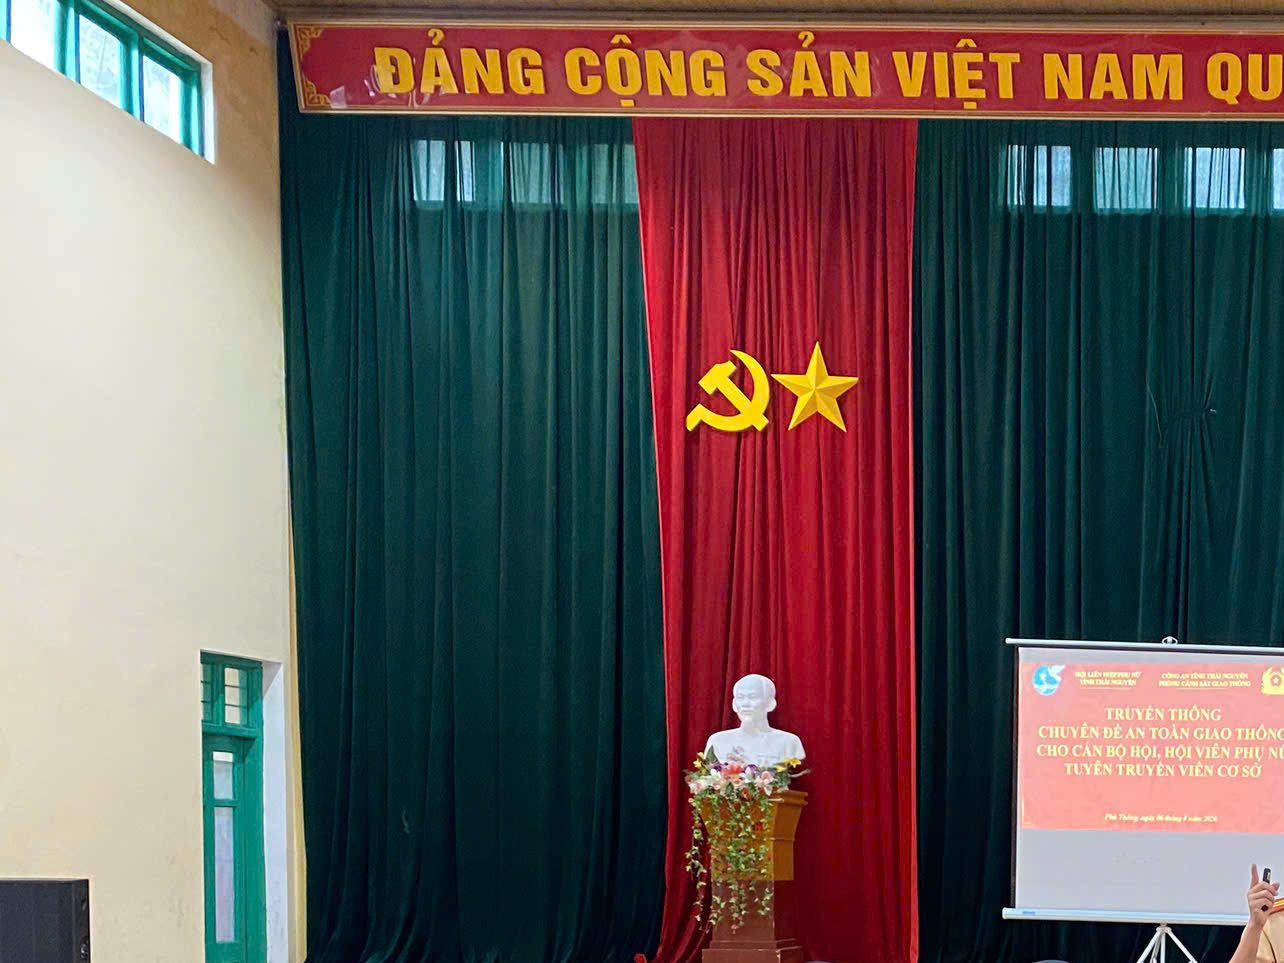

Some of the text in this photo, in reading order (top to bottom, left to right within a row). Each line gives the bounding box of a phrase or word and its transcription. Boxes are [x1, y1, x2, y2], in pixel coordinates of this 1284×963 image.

[374, 28, 546, 95] ĐẢNG
[564, 34, 727, 108] CỘNG
[745, 31, 871, 97] SẢN
[892, 39, 1021, 111] VIỆT
[1042, 52, 1184, 101] NAM
[1169, 704, 1222, 721] THÔNG
[1038, 721, 1100, 739] CHUYÊN
[1126, 727, 1146, 739] AN
[1149, 723, 1190, 740] TOÀN
[1193, 727, 1232, 740] GIAO
[1036, 744, 1069, 757] CHO
[1072, 741, 1103, 757] CÁN
[1105, 743, 1127, 761] BỘ
[1130, 744, 1161, 761] HỘI,
[1164, 744, 1193, 761] HỘI
[1195, 742, 1231, 759] VIÊN
[1234, 746, 1265, 762] PHỤ
[1064, 759, 1112, 776] TUYÊN
[1178, 760, 1214, 777] VIÊN
[1217, 764, 1240, 777] CƠ
[1241, 761, 1262, 778] SỞ
